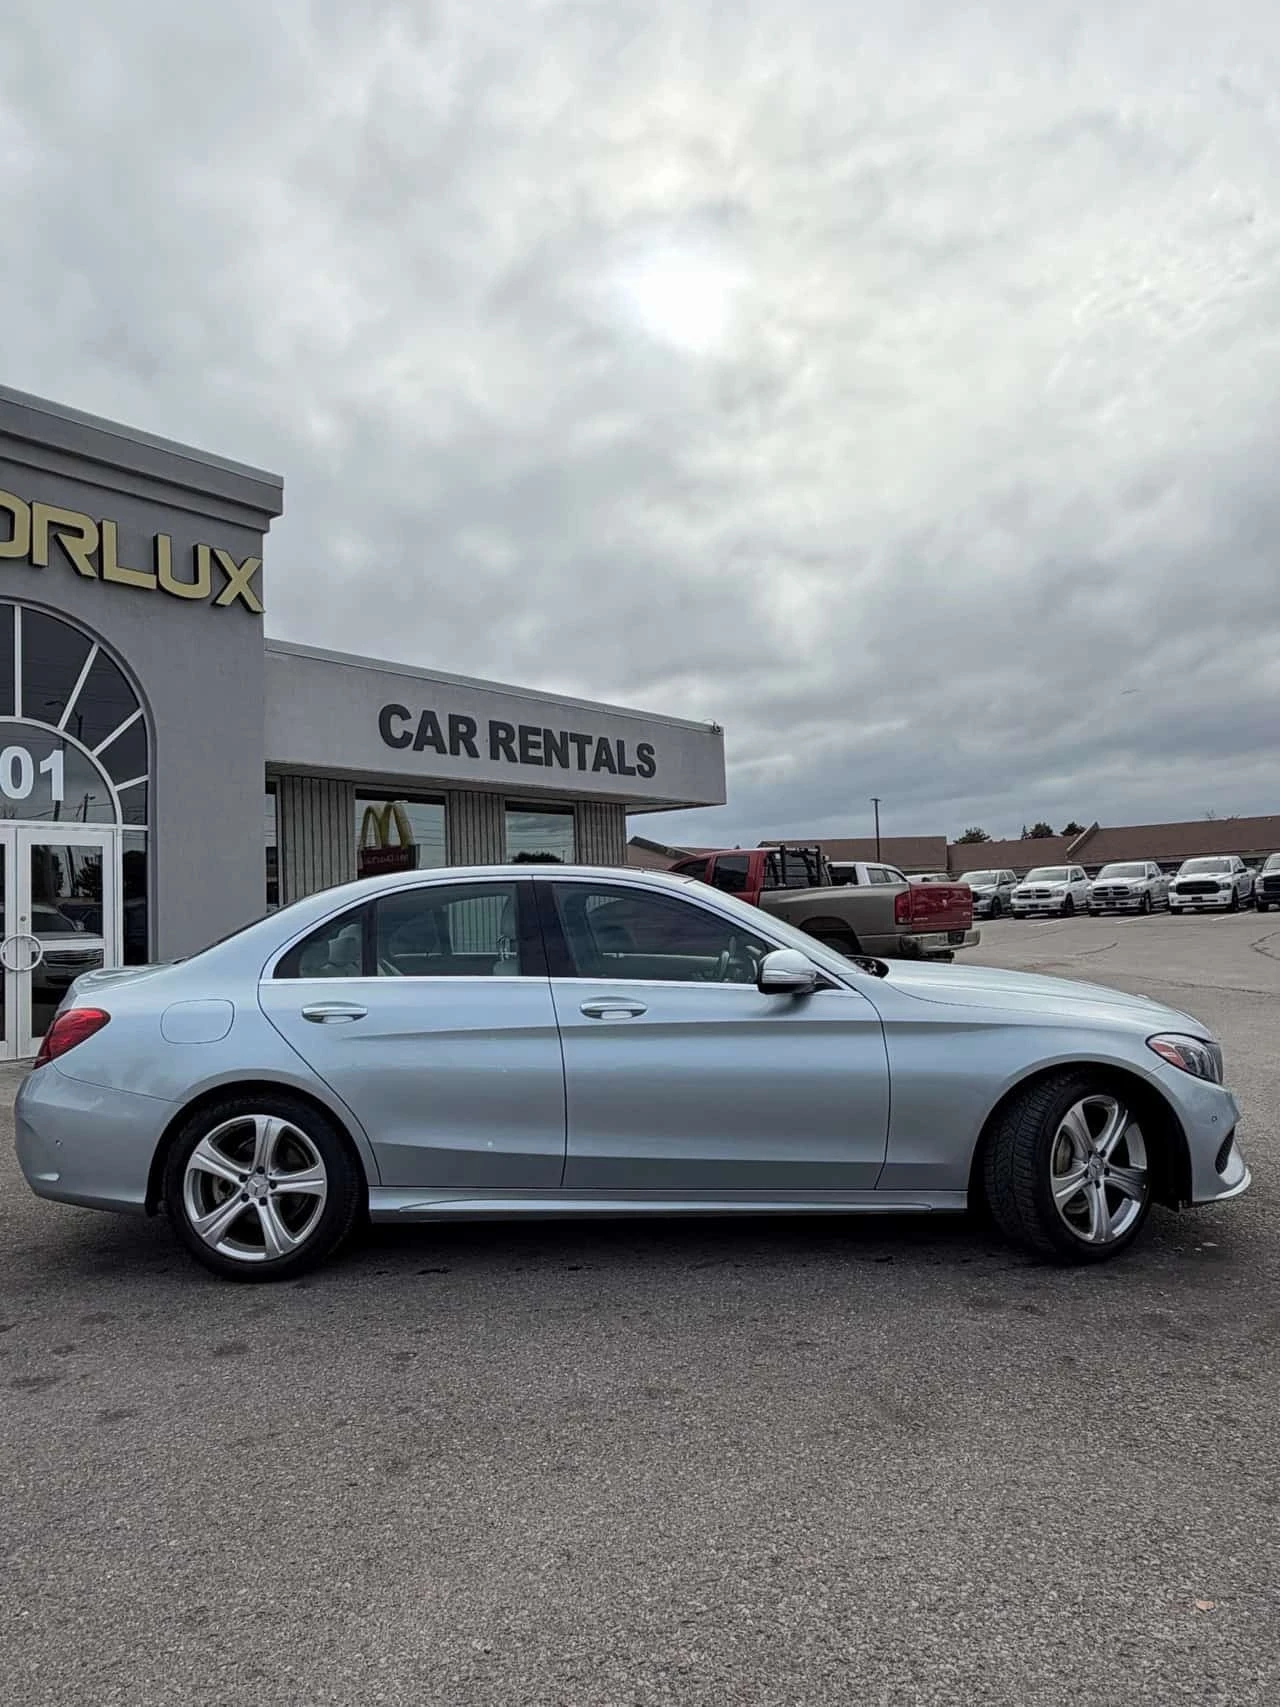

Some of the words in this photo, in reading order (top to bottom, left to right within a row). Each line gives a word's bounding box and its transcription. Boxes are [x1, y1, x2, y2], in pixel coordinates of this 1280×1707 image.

[0, 745, 64, 801] 01
[378, 703, 480, 759] CAR
[488, 719, 656, 778] RENTALS
